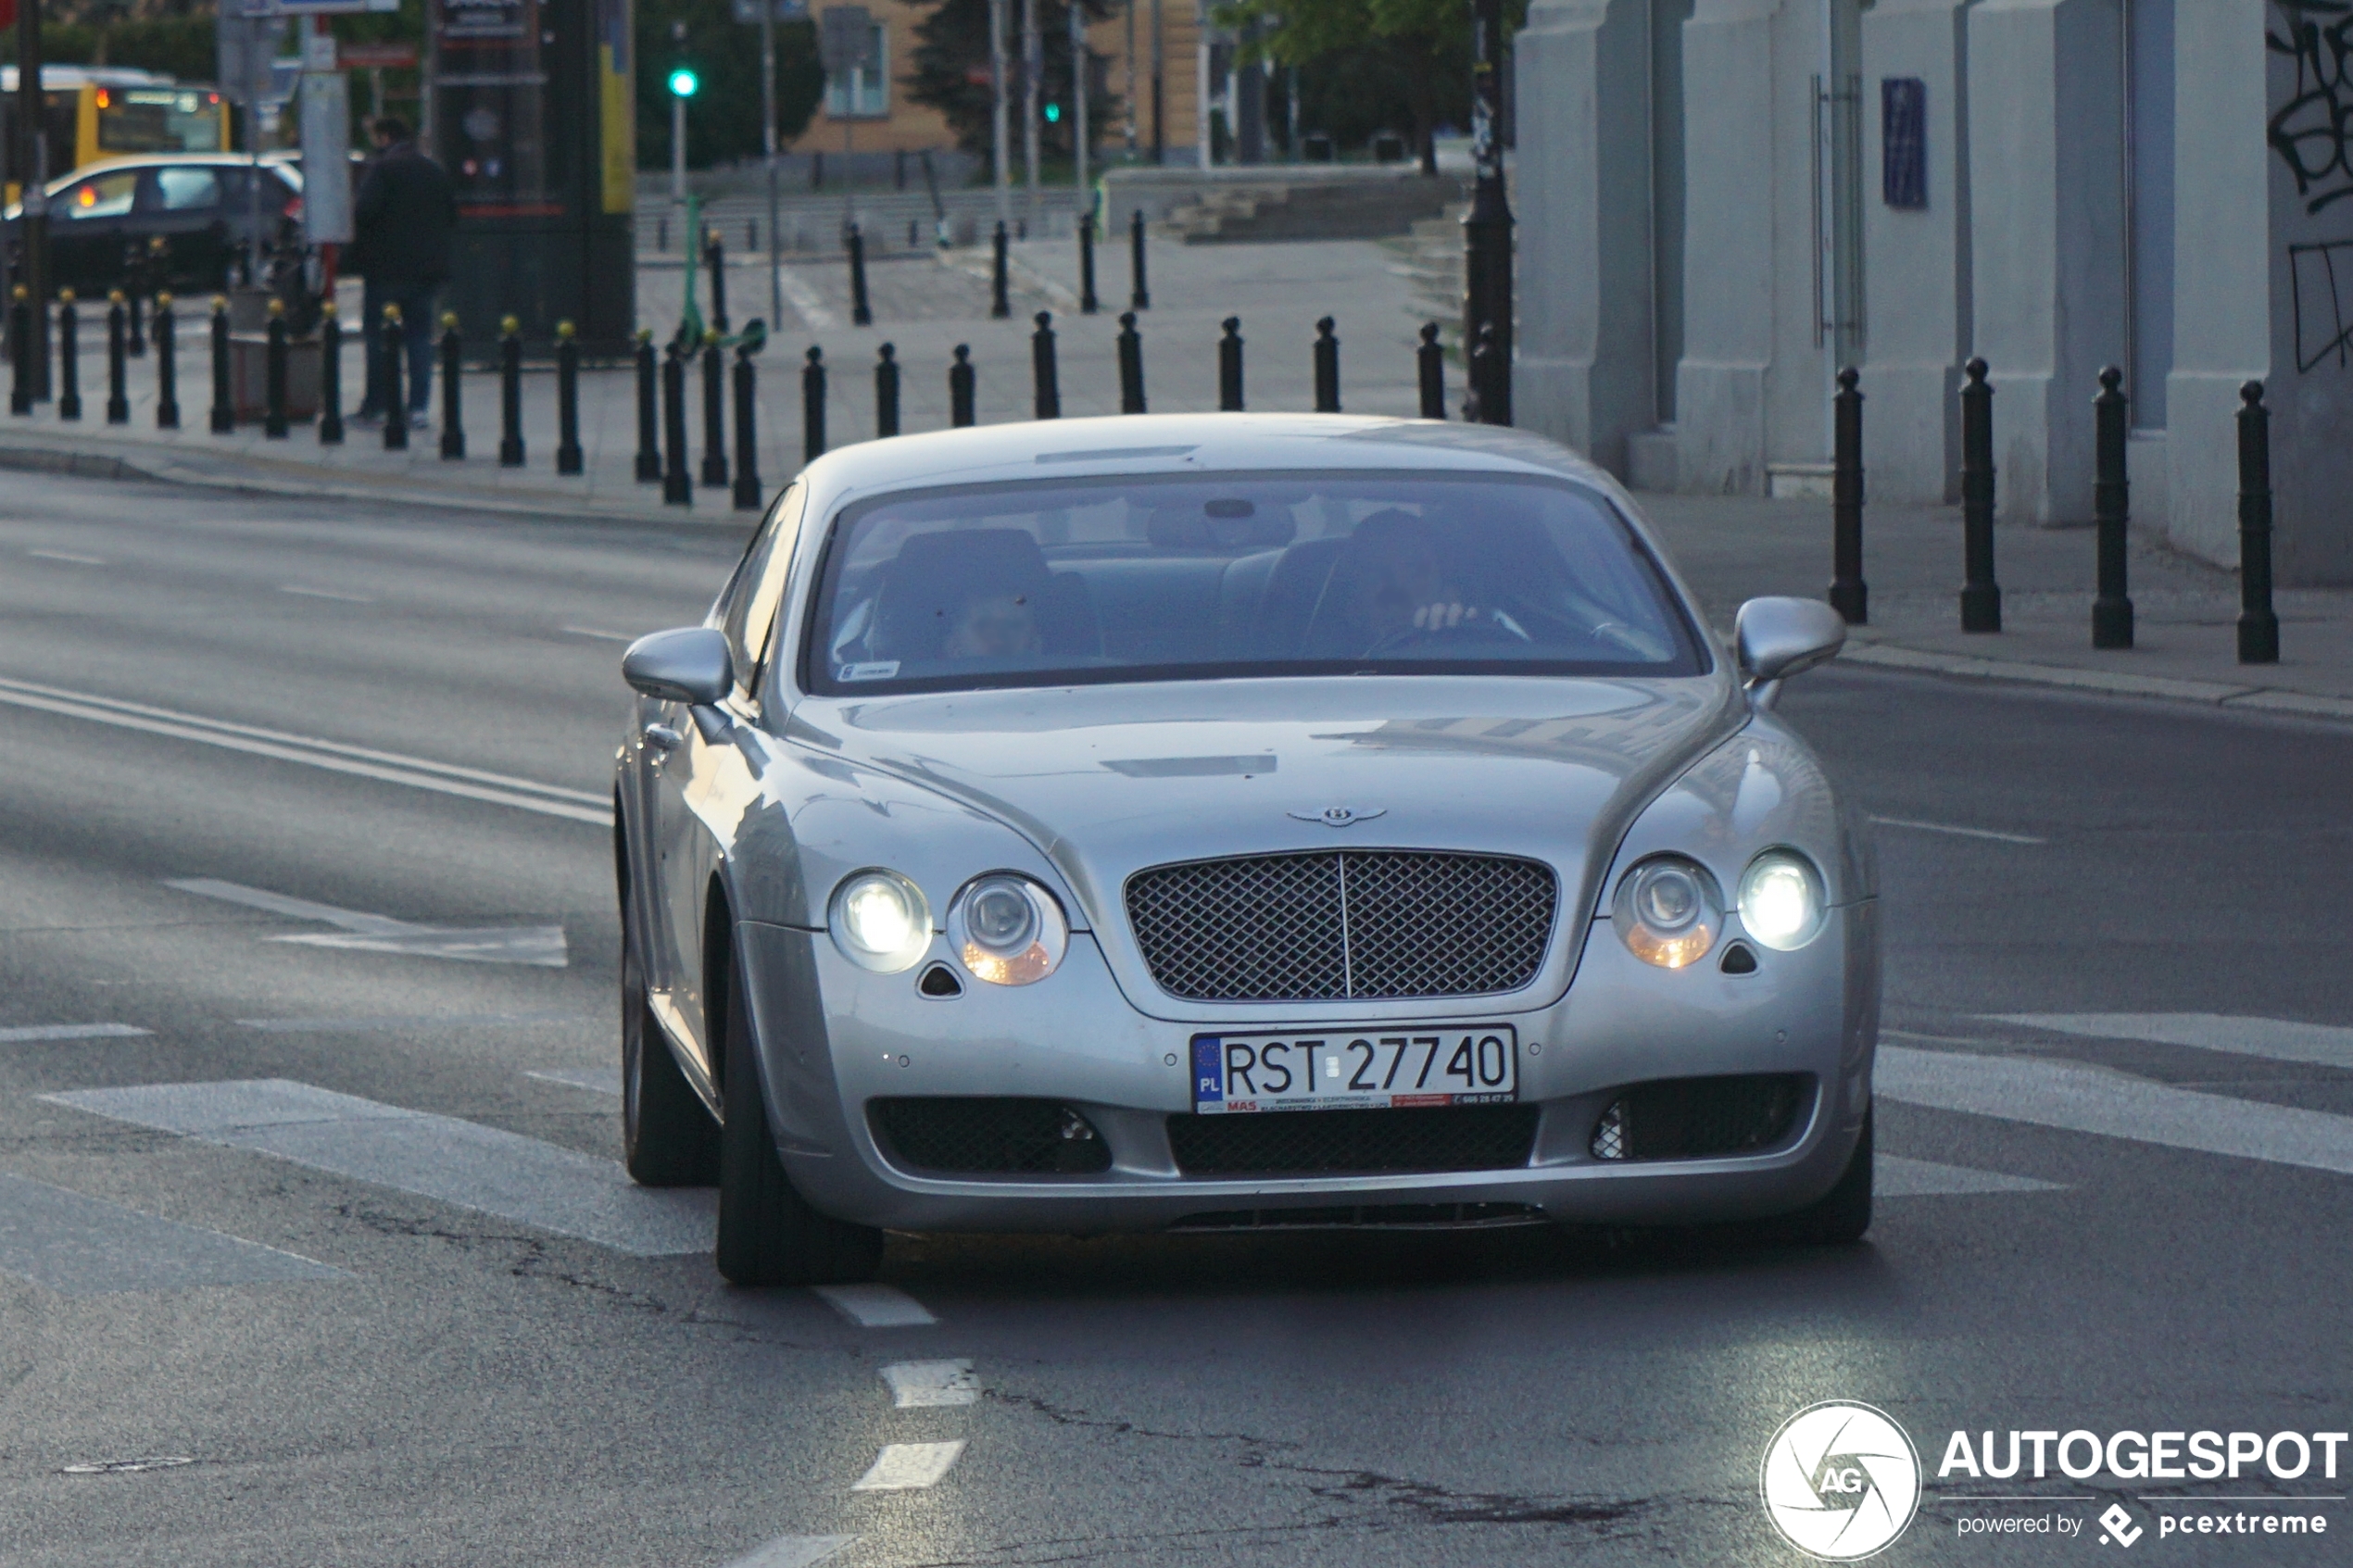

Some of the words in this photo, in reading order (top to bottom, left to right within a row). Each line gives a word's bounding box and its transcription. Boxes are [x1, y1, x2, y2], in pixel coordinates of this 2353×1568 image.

[1225, 1040, 1326, 1096] RST
[1346, 1035, 1505, 1091] 27740
[1200, 1078, 1219, 1093] PL
[1227, 1101, 1257, 1111] MAS
